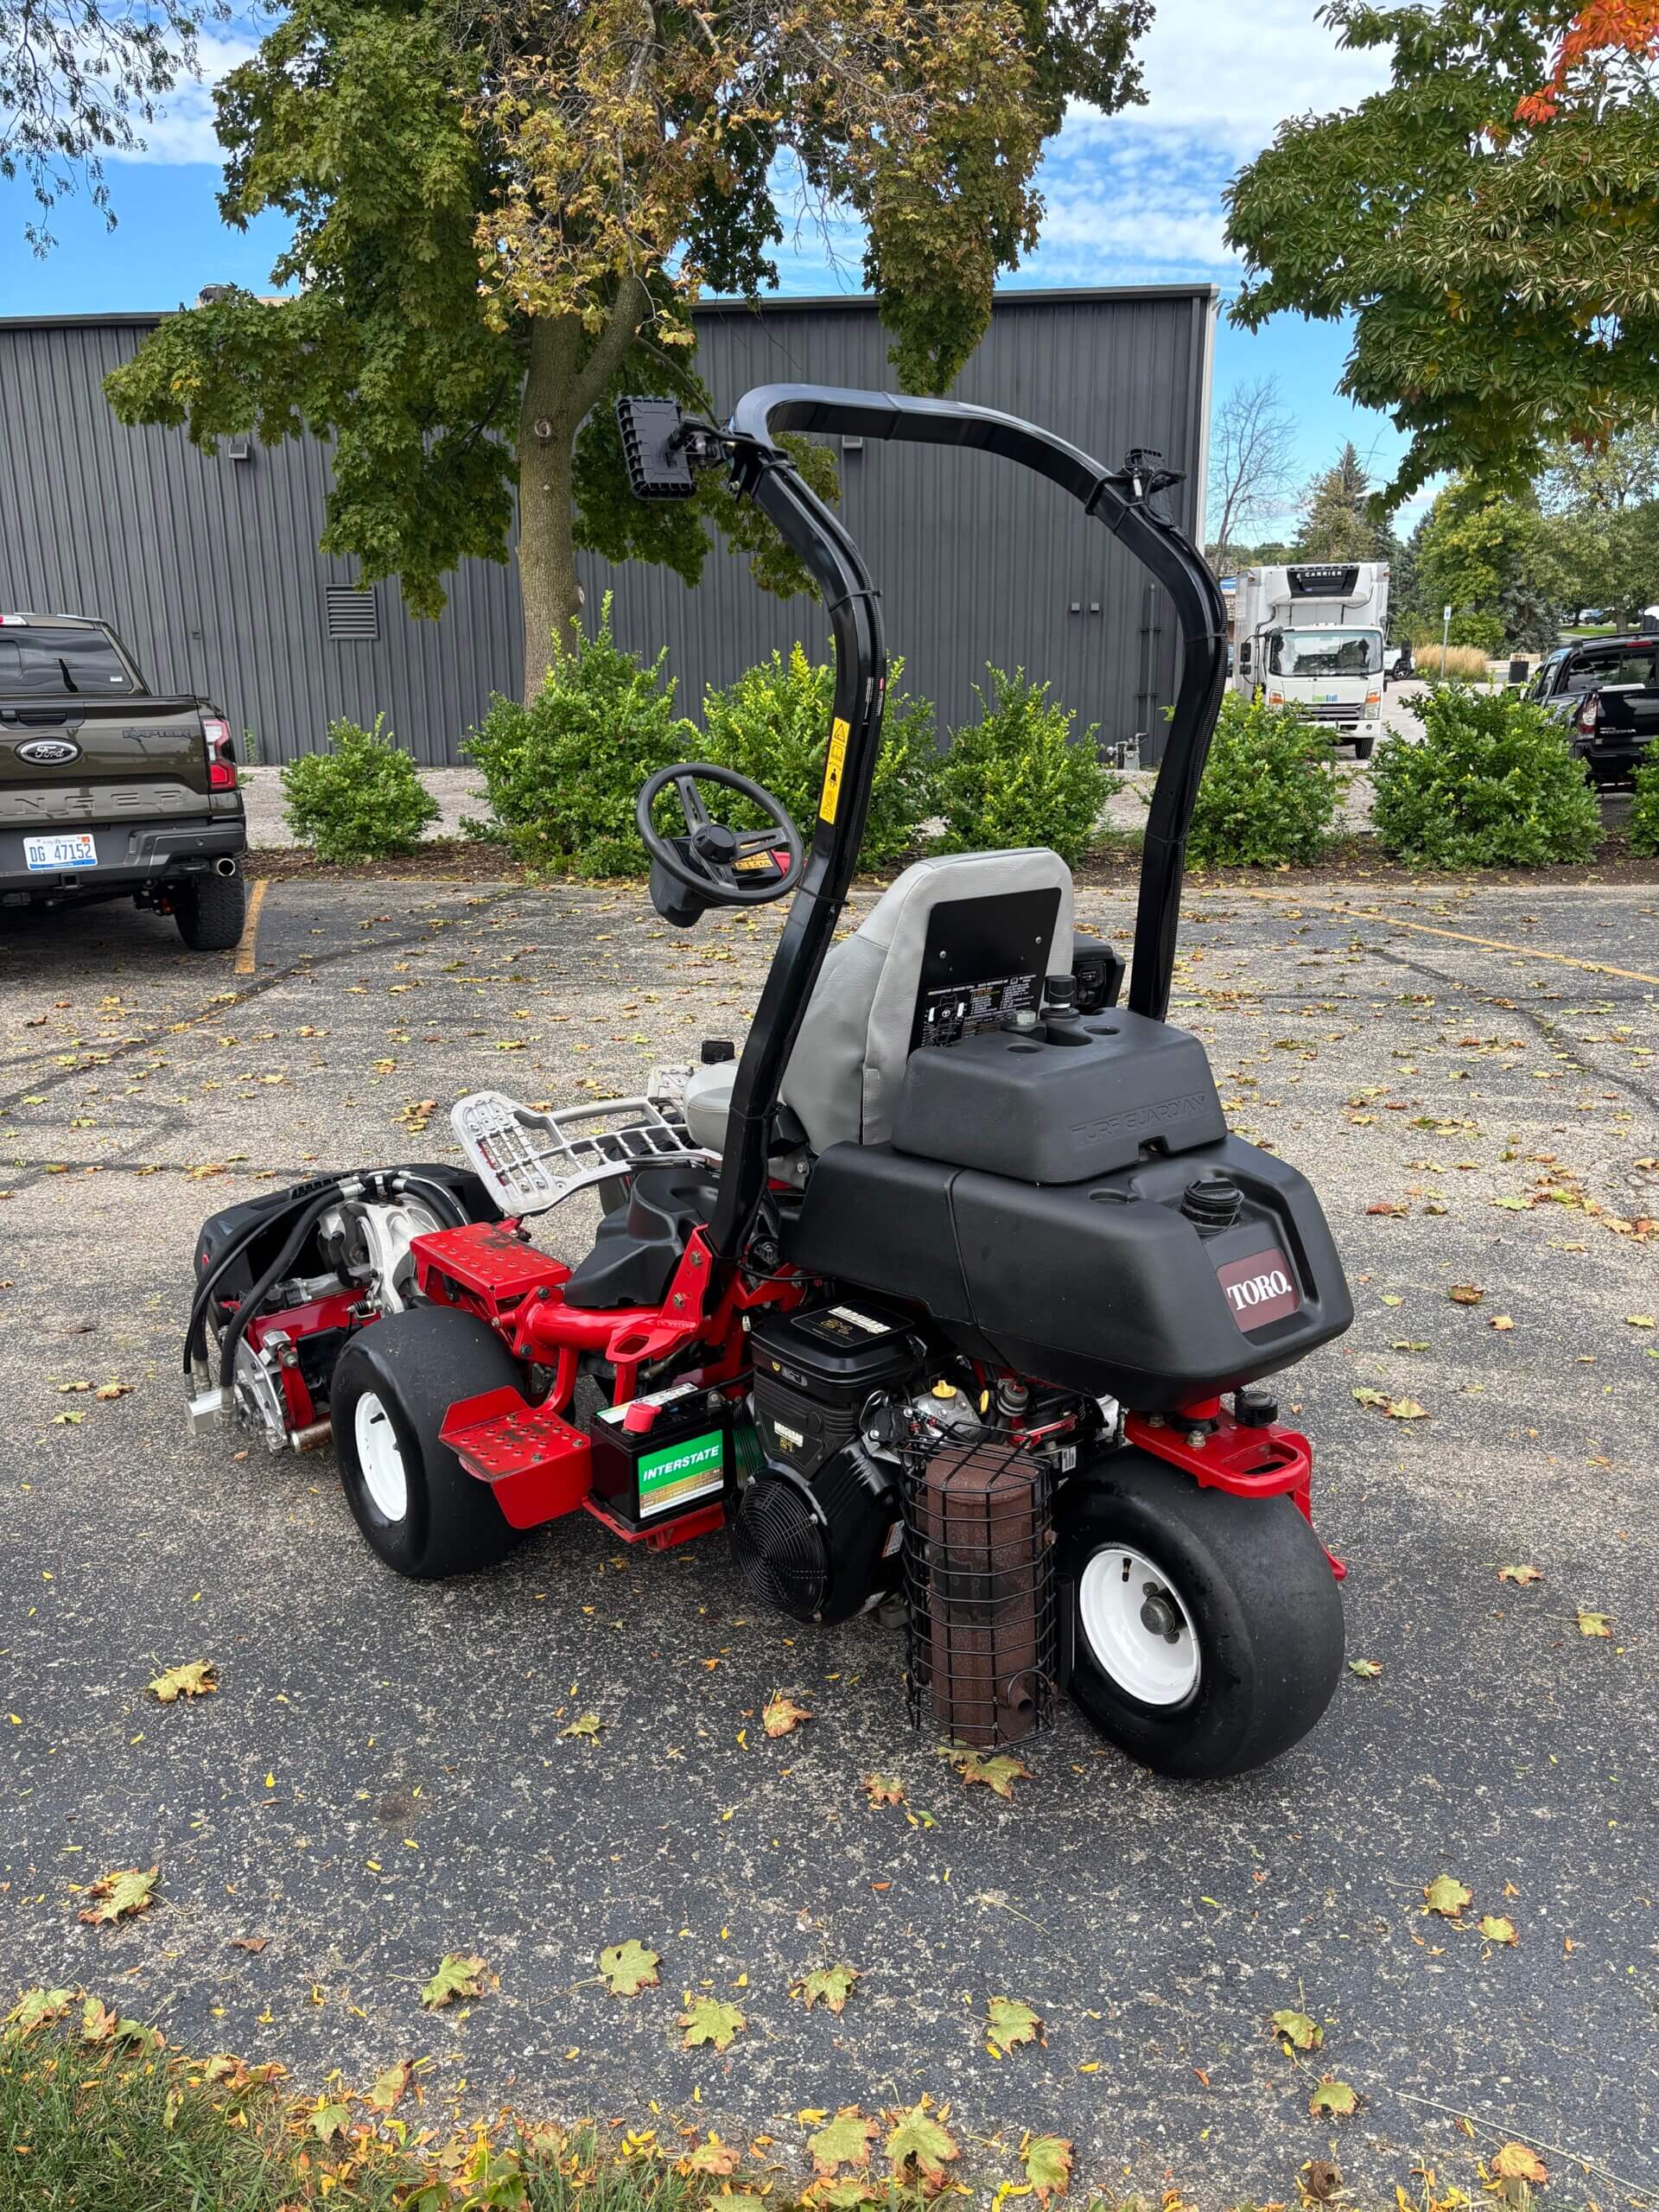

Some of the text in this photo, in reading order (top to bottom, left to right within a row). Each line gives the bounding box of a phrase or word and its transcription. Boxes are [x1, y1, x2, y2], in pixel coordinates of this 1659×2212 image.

[122, 728, 194, 739] RAPTOR
[35, 746, 66, 758] Ford
[0, 790, 183, 817] NGER
[29, 843, 93, 862] DG 47152
[1071, 1095, 1205, 1139] TURF GUARDIAN
[820, 1319, 854, 1335] 21
[779, 1437, 793, 1452] 21
[643, 1445, 720, 1482] INTERSTATE
